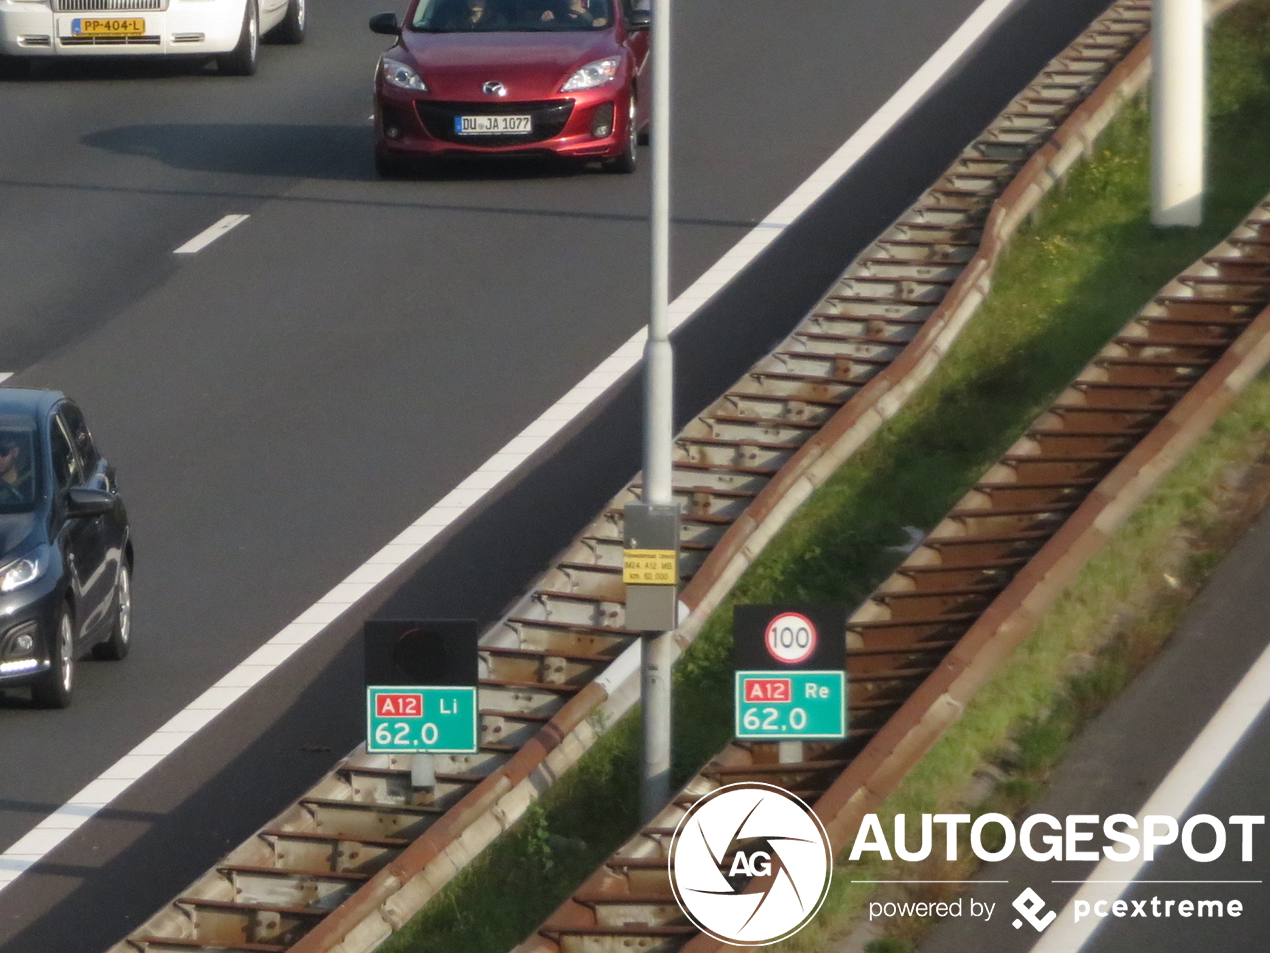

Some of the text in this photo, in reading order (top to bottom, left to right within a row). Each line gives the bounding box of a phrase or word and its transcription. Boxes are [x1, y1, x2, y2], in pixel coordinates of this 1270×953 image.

[84, 20, 140, 31] PP-404-L
[462, 117, 530, 130] DU JA 1077
[772, 626, 810, 649] 100
[750, 682, 829, 699] A12 Re
[381, 697, 458, 714] A12 Li
[743, 707, 807, 732] 62,0
[375, 722, 439, 746] 62,0
